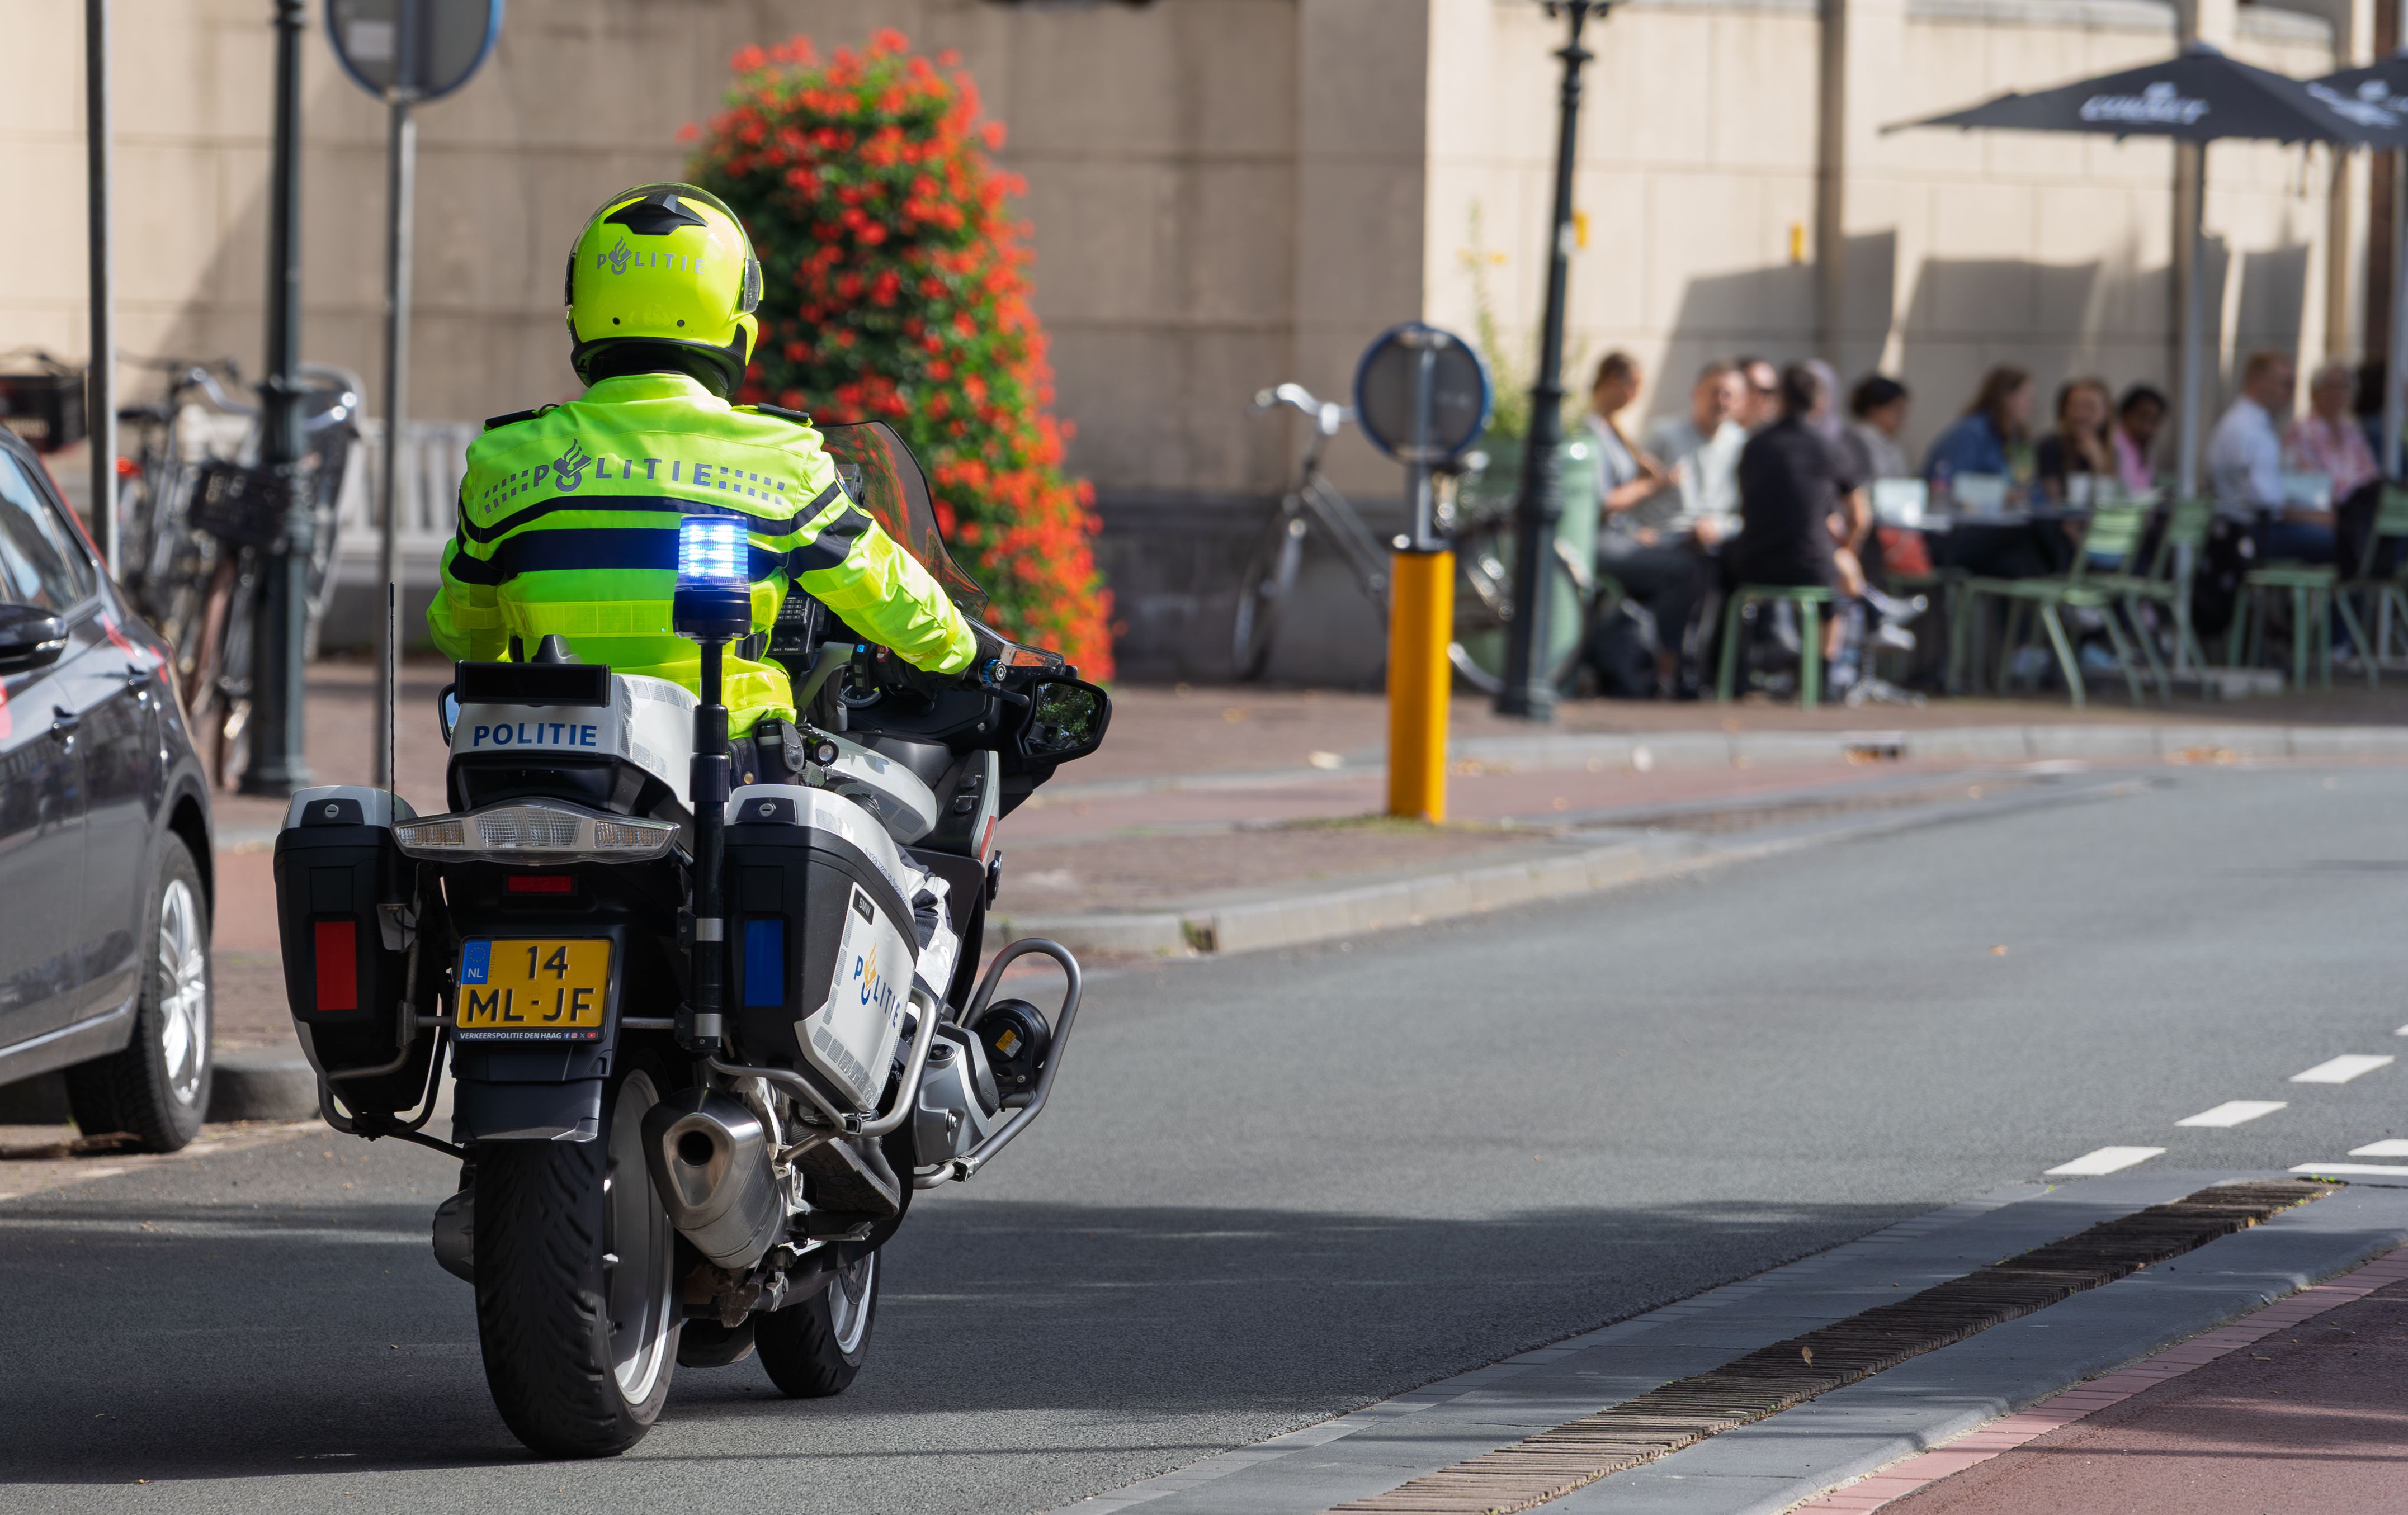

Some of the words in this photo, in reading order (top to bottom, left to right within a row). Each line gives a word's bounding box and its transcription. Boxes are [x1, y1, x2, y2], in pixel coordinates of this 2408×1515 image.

[473, 722, 597, 747] POLITIE
[858, 897, 871, 917] BMW
[468, 968, 483, 978] NL
[528, 945, 569, 980] 14
[853, 955, 900, 1028] POLITIE
